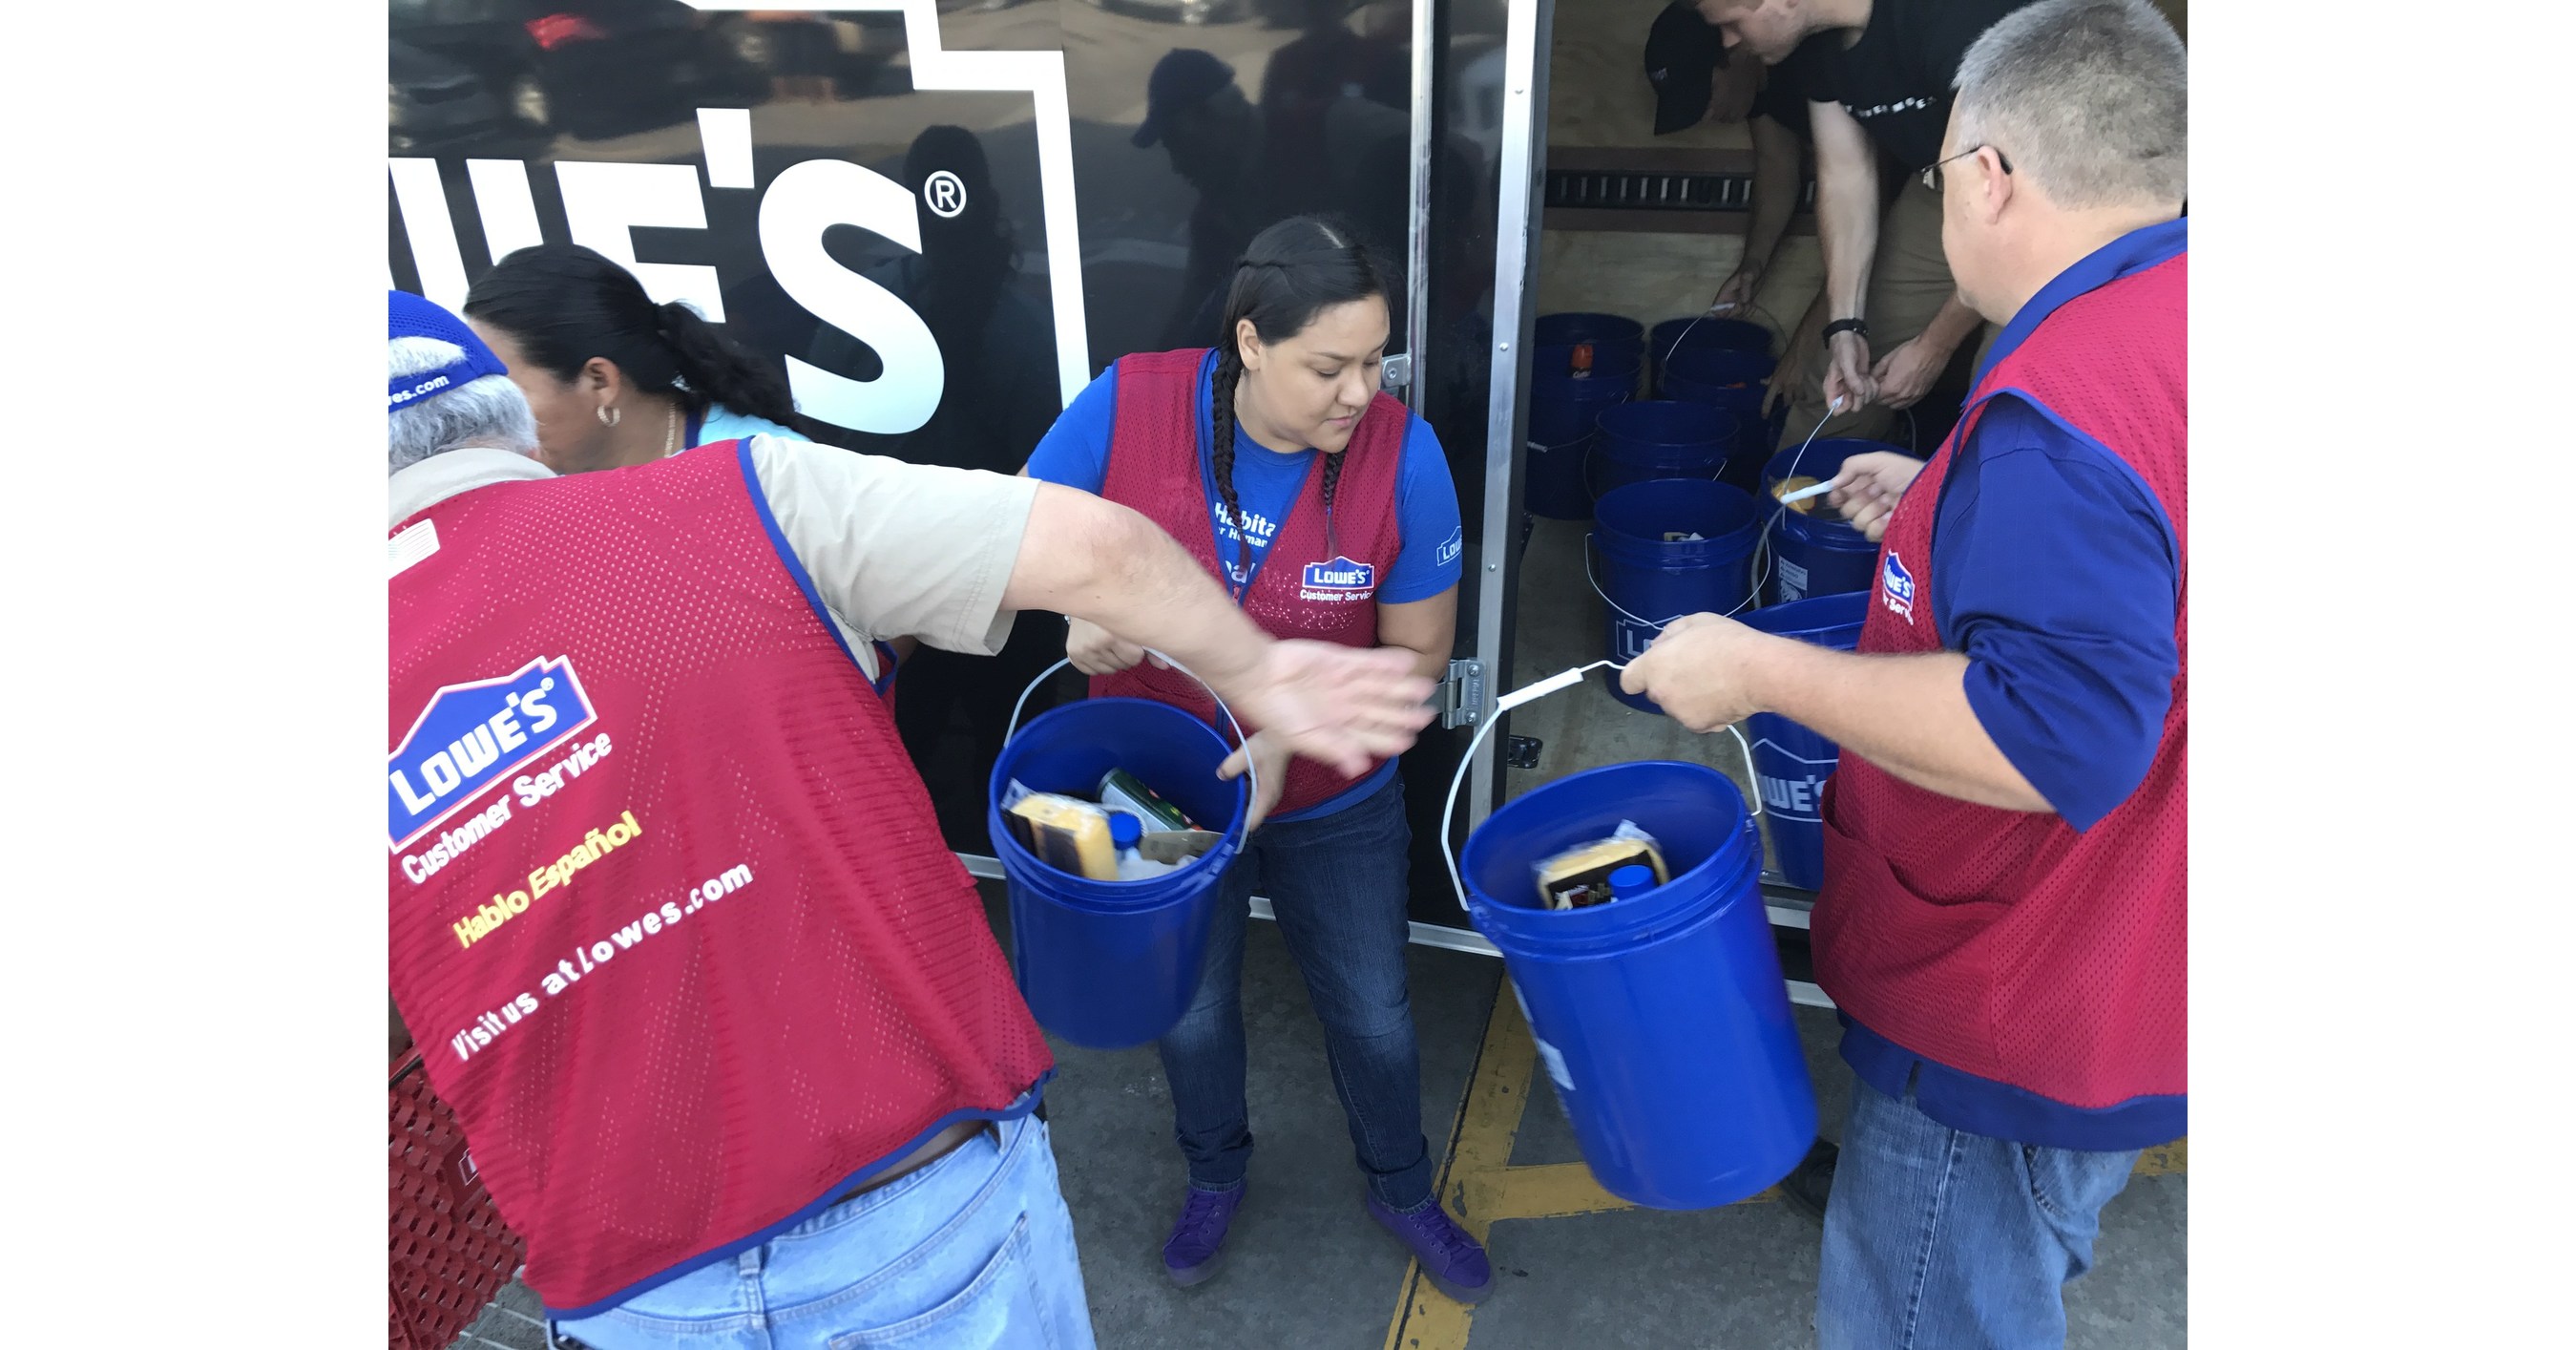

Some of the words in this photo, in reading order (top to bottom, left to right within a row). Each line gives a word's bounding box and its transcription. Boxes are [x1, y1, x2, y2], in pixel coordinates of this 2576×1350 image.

[388, 375, 450, 406] es.com
[1300, 589, 1343, 601] Customer
[1313, 568, 1366, 584] LOWE'S
[401, 794, 513, 884] Customer
[513, 732, 613, 807] Service
[452, 890, 531, 949] Hablo
[527, 810, 643, 899] Español
[451, 1010, 507, 1062] Visit
[501, 991, 539, 1024] us
[540, 959, 581, 996] at
